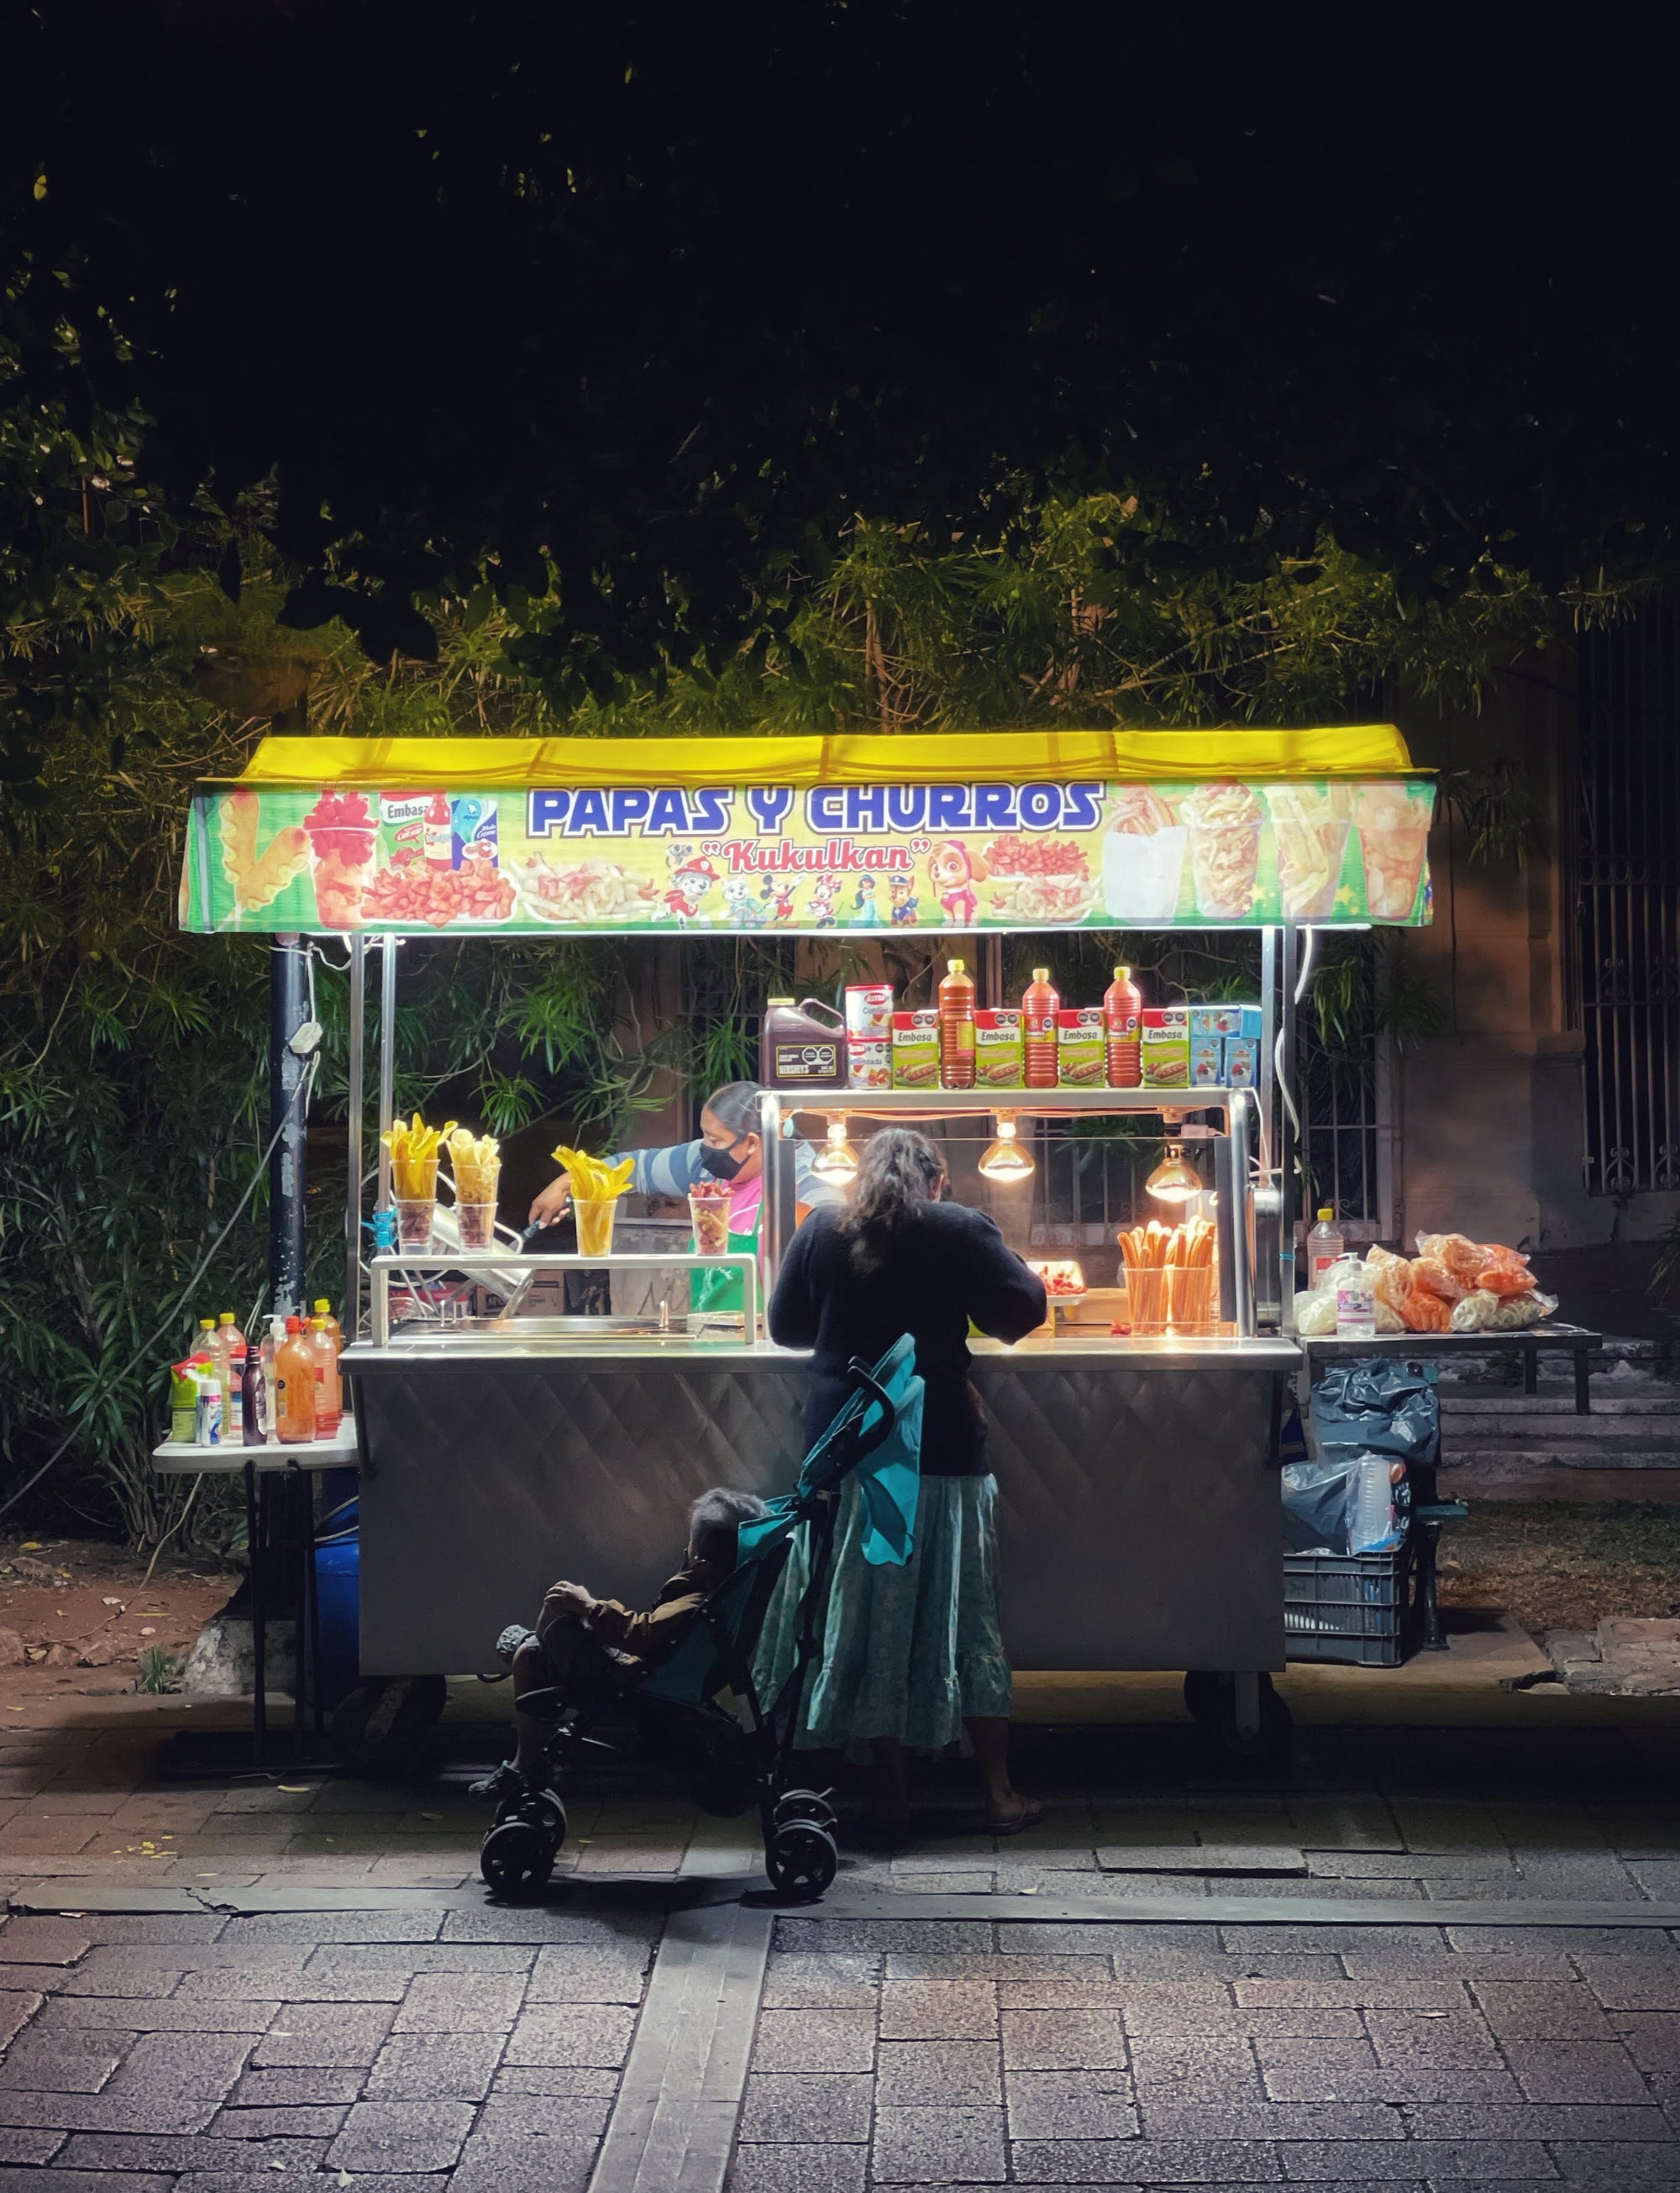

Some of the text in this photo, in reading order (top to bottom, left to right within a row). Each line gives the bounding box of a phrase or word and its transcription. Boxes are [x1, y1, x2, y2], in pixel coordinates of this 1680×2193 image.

[527, 783, 1107, 838] PAPAS Y CHURROS
[898, 1031, 932, 1042] Embasa
[981, 1031, 1015, 1041] Embasa
[1063, 1031, 1098, 1041] Embasa
[1148, 1030, 1183, 1040] Embasa
